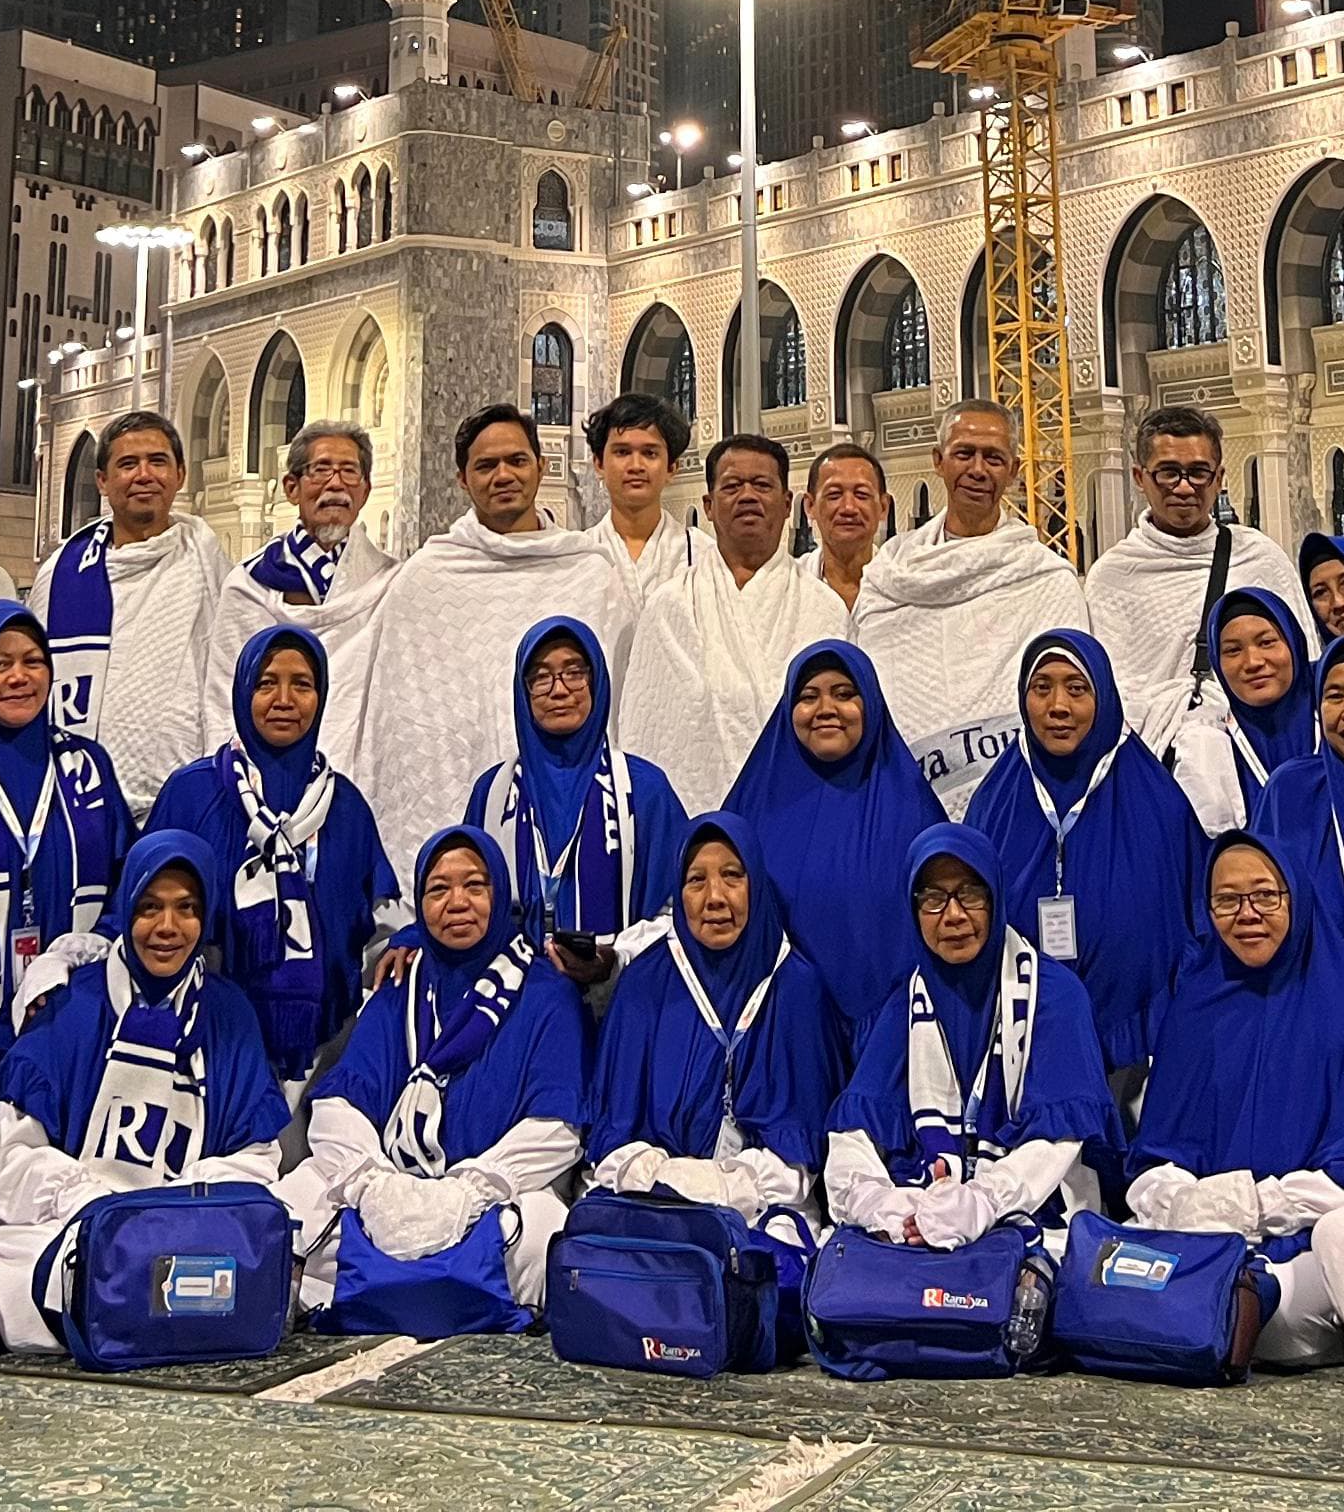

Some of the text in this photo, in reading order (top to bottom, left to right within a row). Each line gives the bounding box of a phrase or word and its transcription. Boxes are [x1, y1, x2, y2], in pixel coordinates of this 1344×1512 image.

[52, 675, 93, 726] R
[96, 1096, 168, 1168] R
[641, 1336, 661, 1360] R
